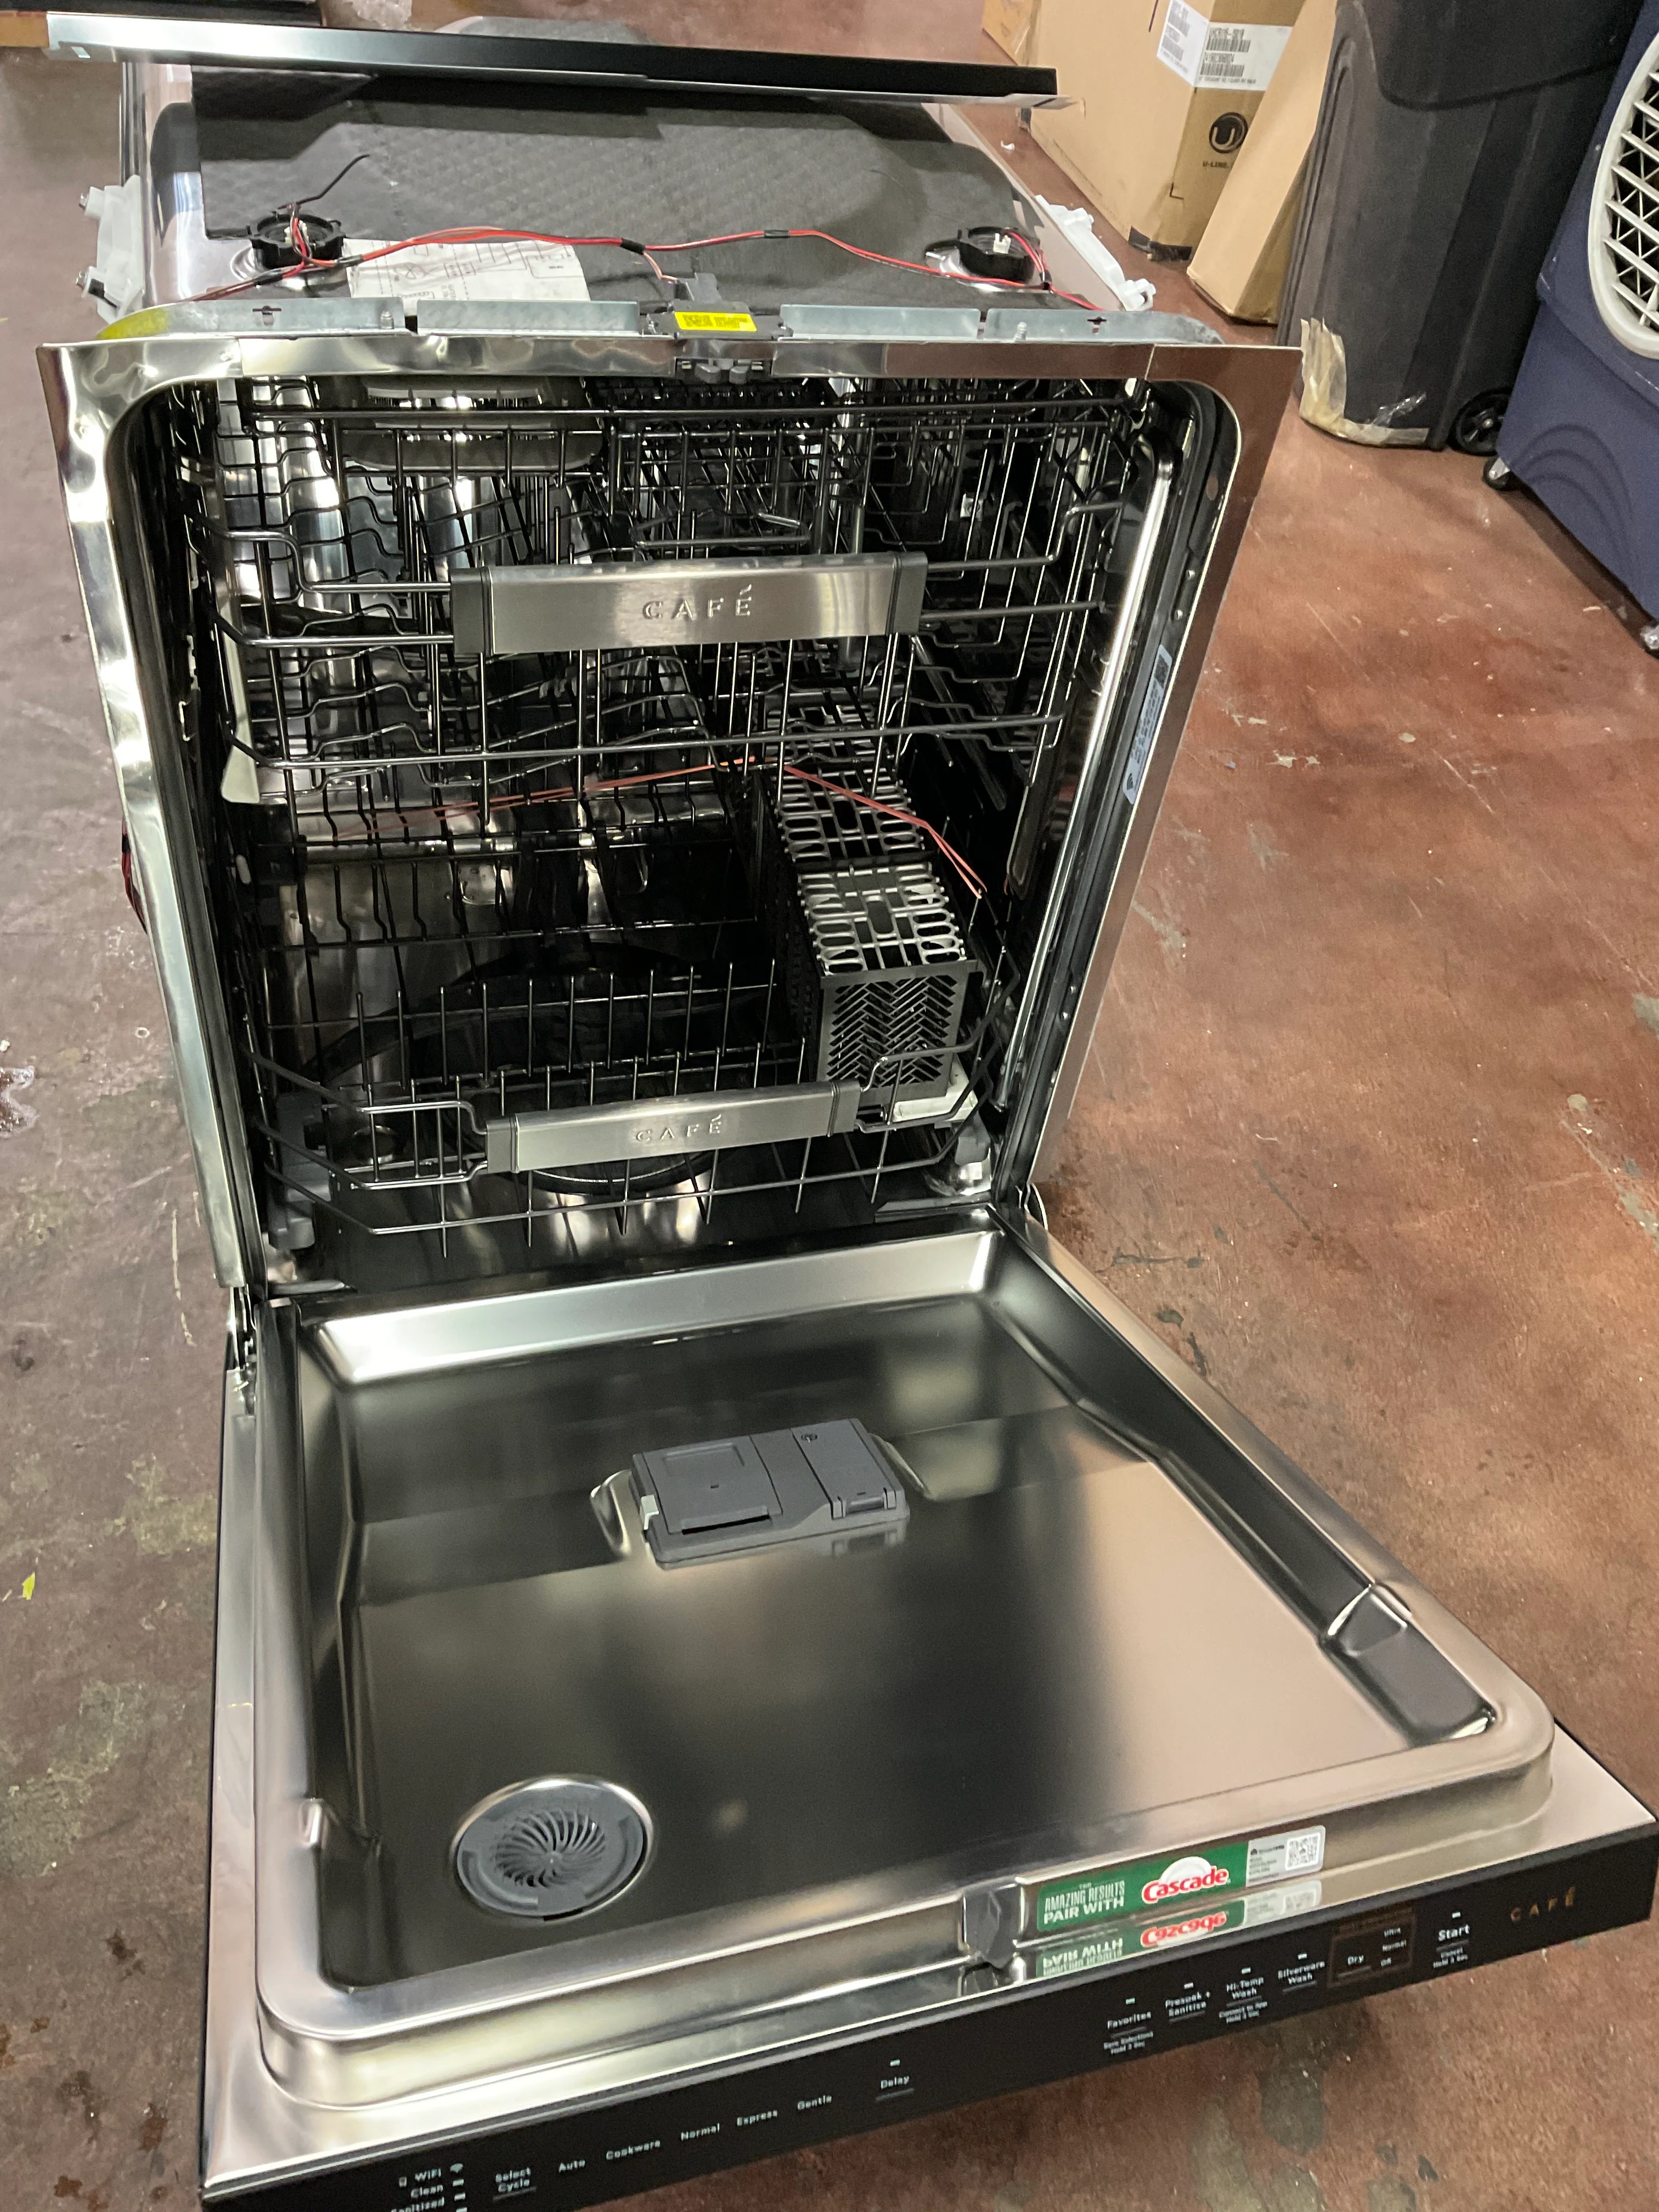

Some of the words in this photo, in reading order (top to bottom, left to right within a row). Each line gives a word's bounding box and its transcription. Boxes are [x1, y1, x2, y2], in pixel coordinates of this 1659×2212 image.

[642, 584, 752, 621] CAFÉ
[636, 1113, 722, 1141] CAFÉ
[1143, 1866, 1228, 1903] Cascade
[1045, 1889, 1086, 1913] AMAZING
[1088, 1880, 1125, 1904] RESULTS
[1043, 1906, 1080, 1925] PAIR
[1083, 1896, 1124, 1915] WITH
[1438, 1924, 1470, 1942] Start
[1347, 1955, 1364, 1966] Dry
[1278, 1961, 1325, 1980] Silverware
[1288, 1972, 1313, 1985] Wash
[1232, 1987, 1257, 2000] Wash
[1107, 2011, 1151, 2030] Favorites
[880, 2075, 910, 2090] Delay
[797, 2095, 832, 2111] Gentle
[681, 2122, 720, 2142] Normal
[606, 2140, 661, 2160] Cookware
[495, 2166, 532, 2183] Select
[558, 2159, 586, 2174] Auto
[411, 2185, 443, 2199] Clean
[498, 2178, 530, 2193] Cycle
